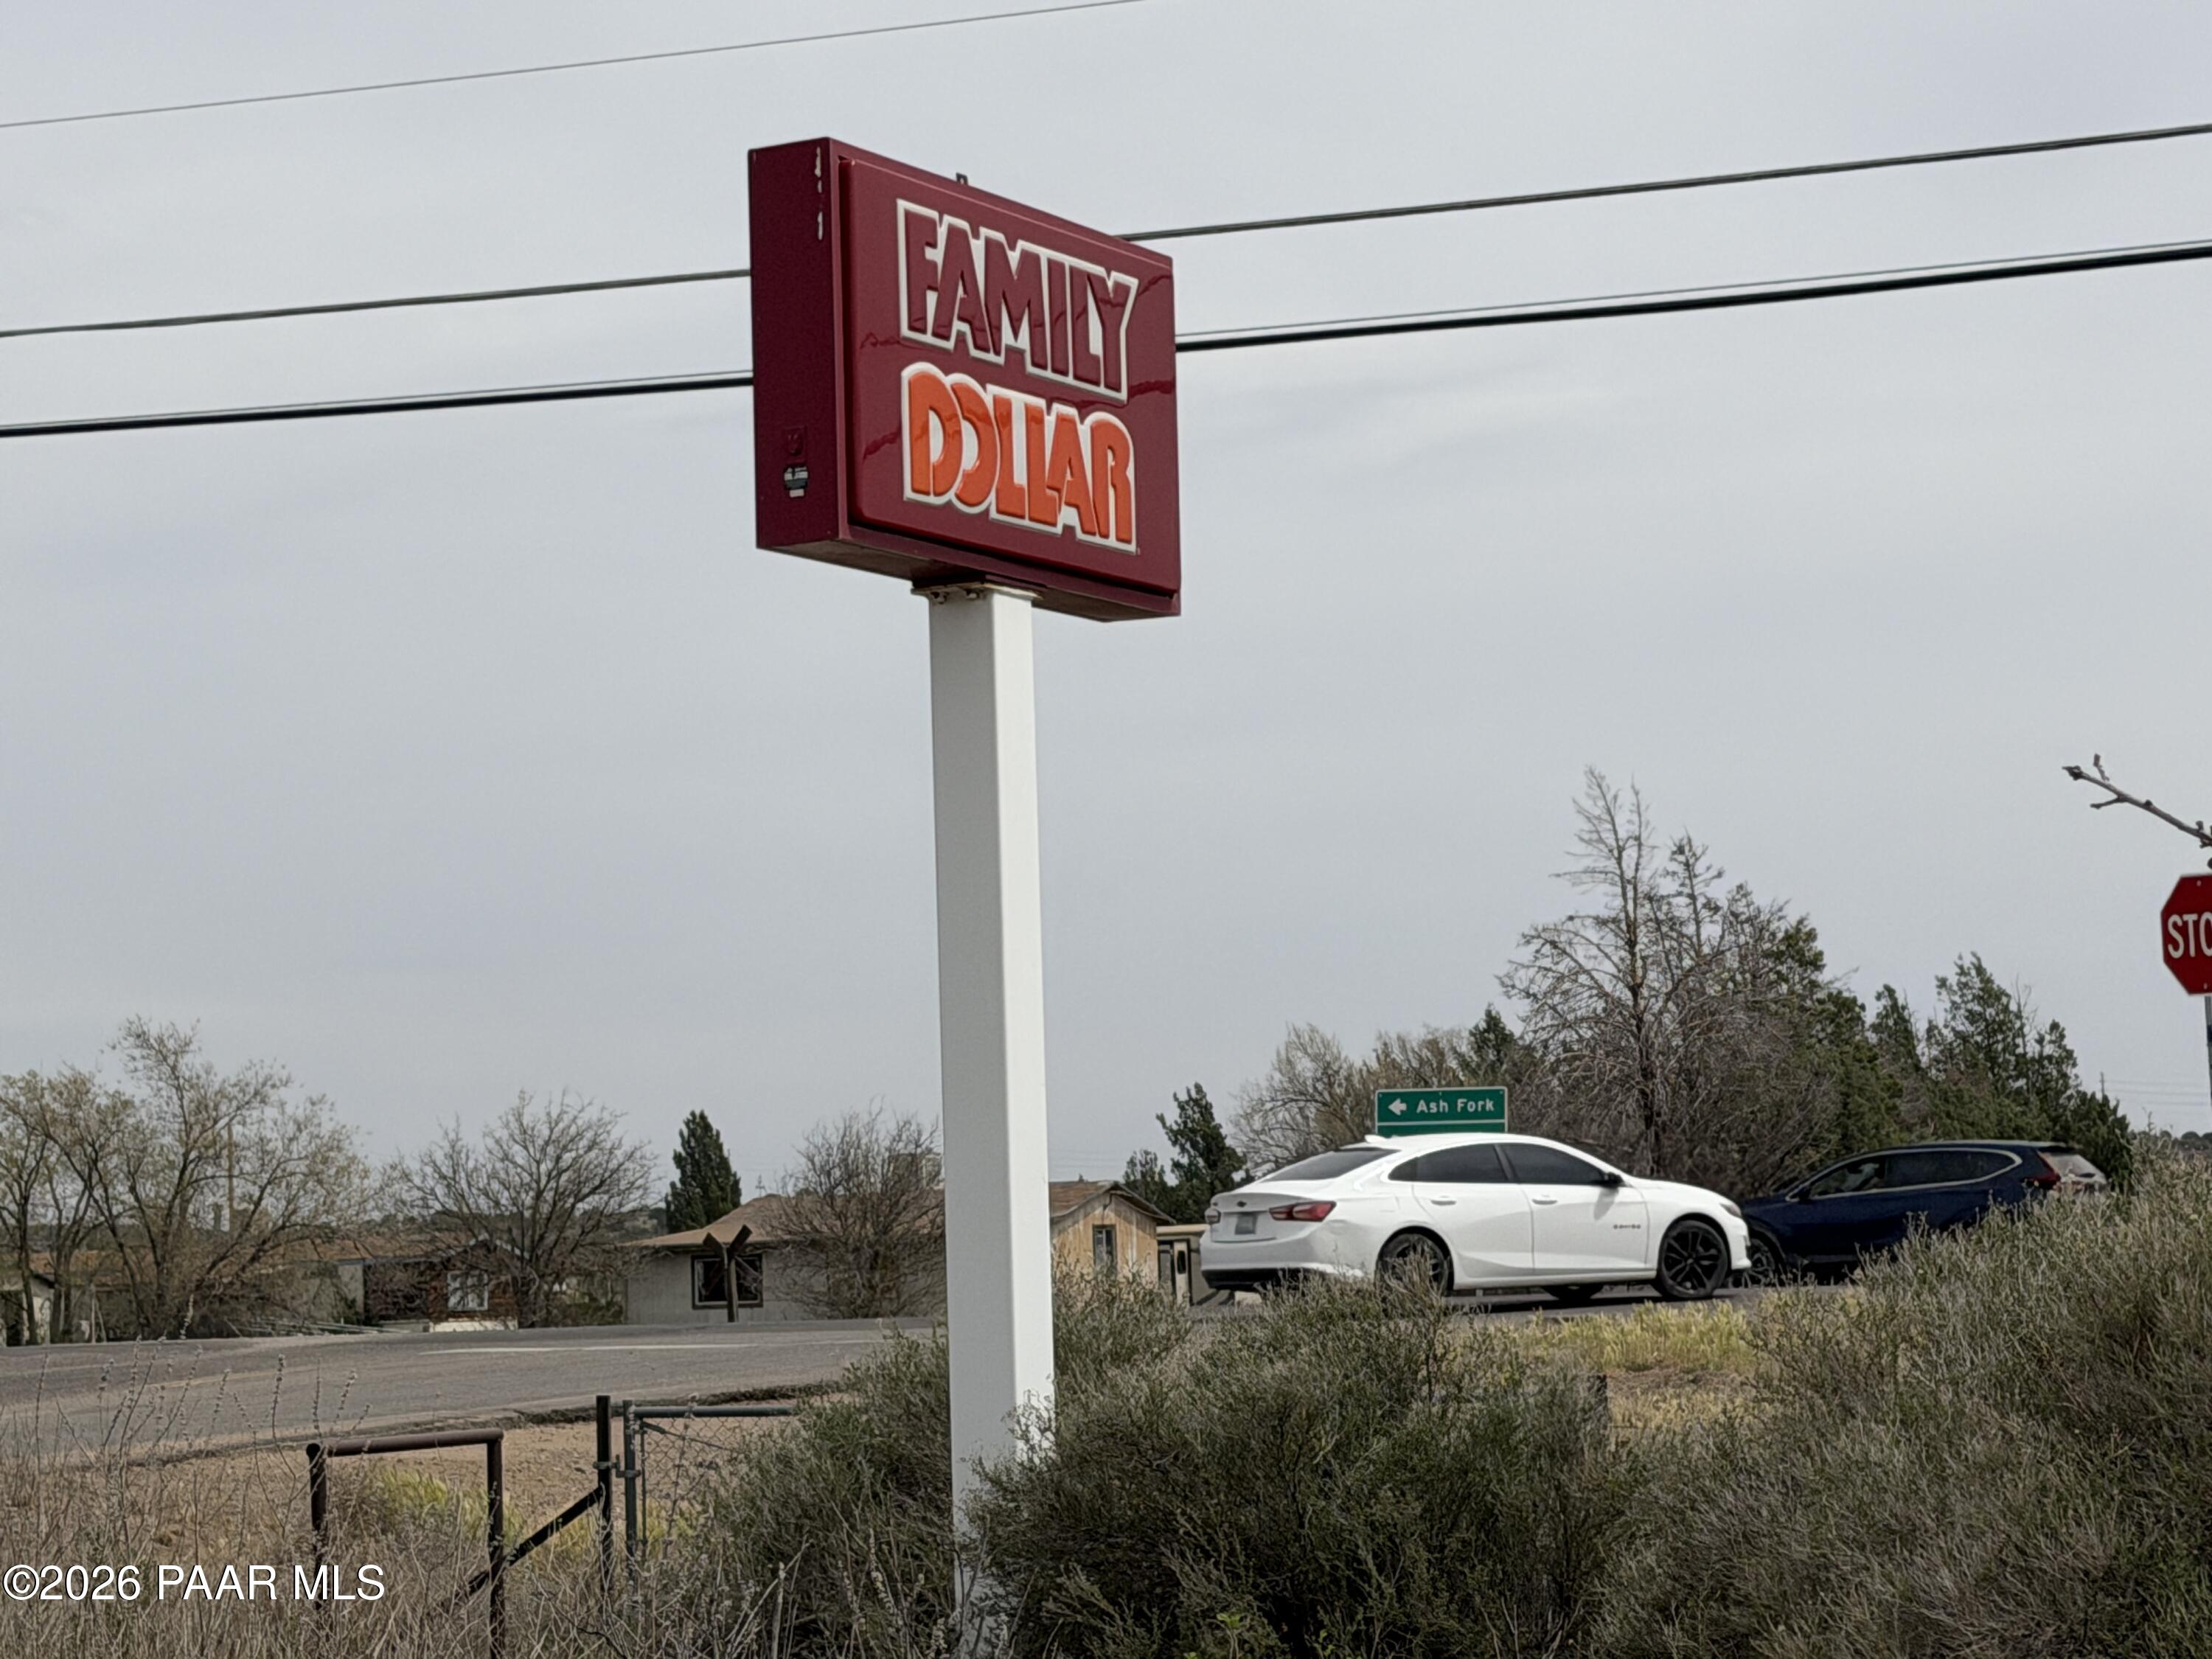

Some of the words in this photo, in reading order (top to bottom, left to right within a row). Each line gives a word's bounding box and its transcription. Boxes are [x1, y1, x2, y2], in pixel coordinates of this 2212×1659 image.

[897, 198, 1138, 403] FAMILY
[901, 362, 1138, 554] DOLLAR
[1416, 1099, 1449, 1113] Ash
[1456, 1098, 1495, 1112] Fork
